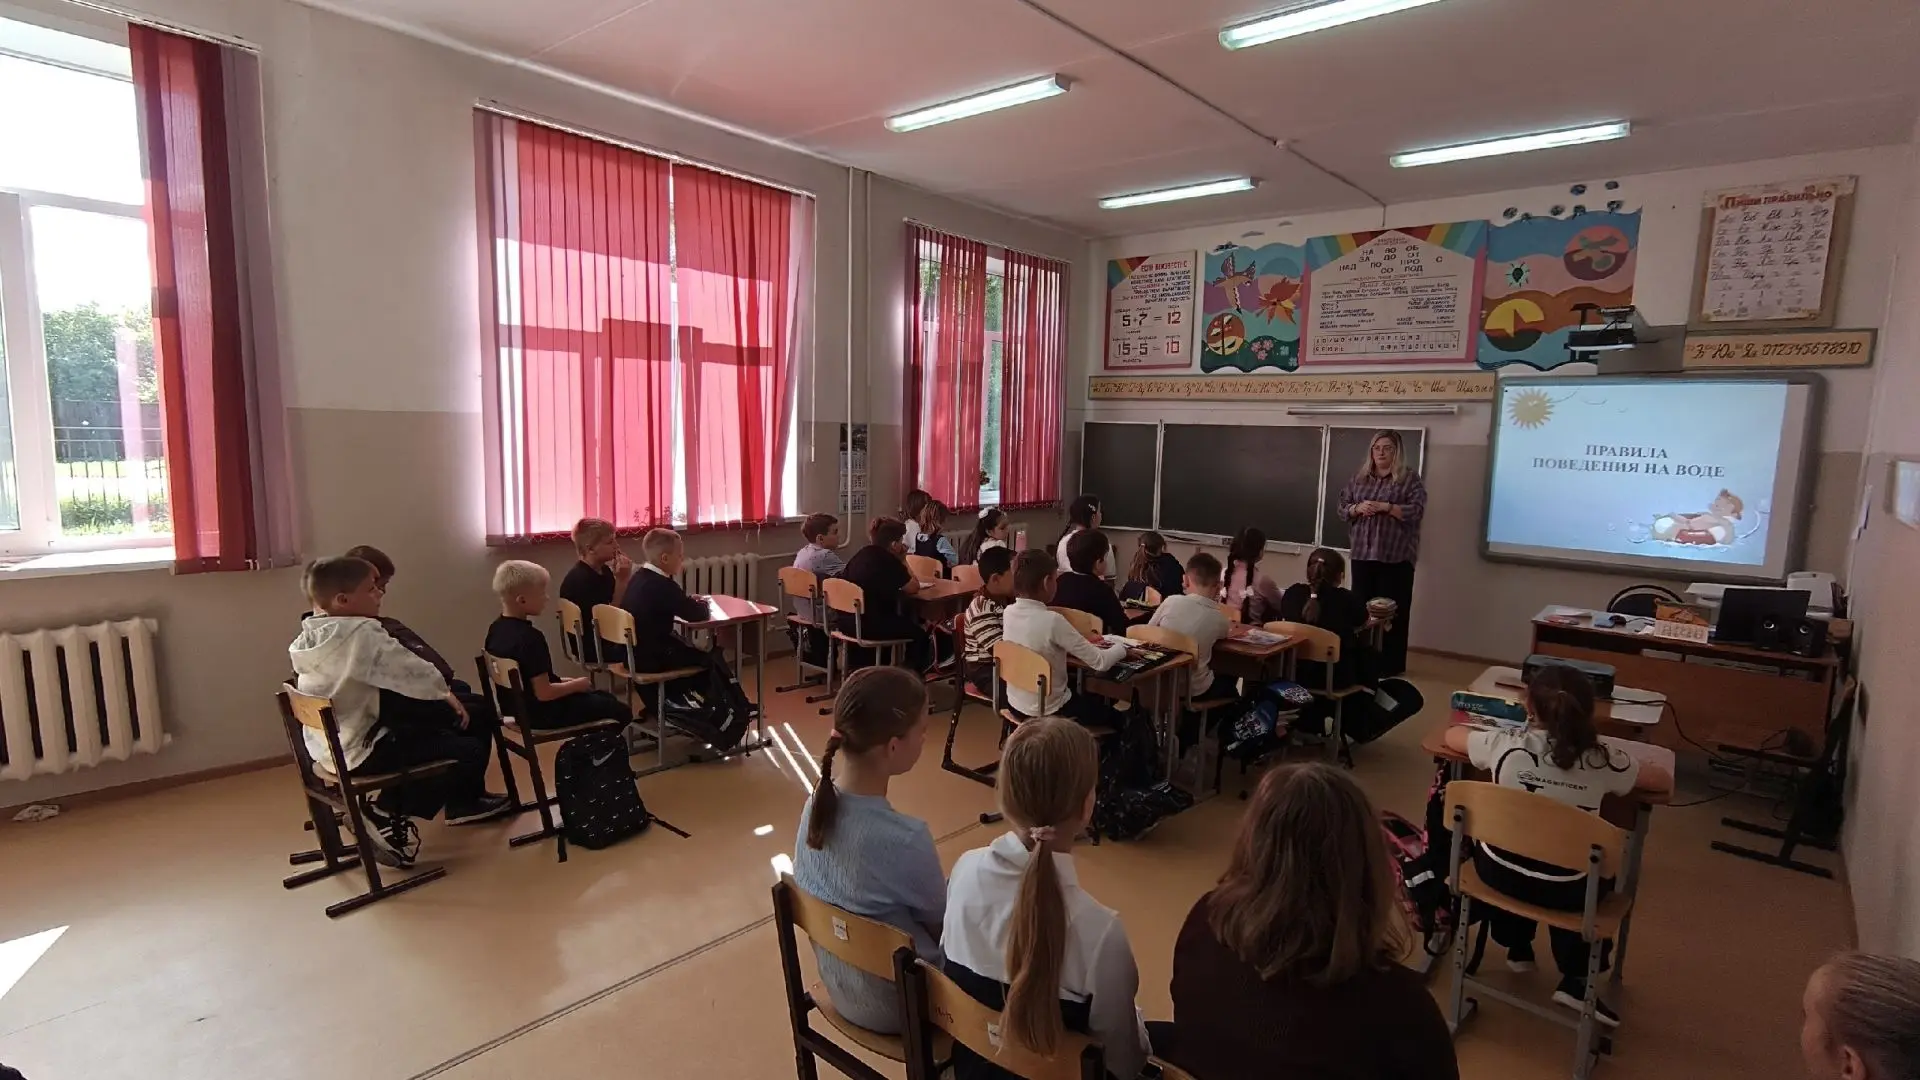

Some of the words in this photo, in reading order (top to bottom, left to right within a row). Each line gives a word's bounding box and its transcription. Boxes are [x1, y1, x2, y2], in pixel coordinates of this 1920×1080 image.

[1362, 248, 1374, 256] НА
[1370, 261, 1382, 269] ПО
[1167, 311, 1181, 325] 12
[1166, 341, 1180, 355] 10
[1584, 444, 1669, 459] ПРАВИЛА
[1532, 457, 1640, 473] ПОВЕДЕНИЯ
[1644, 463, 1670, 475] НА
[1675, 464, 1725, 478] ВОДЕ
